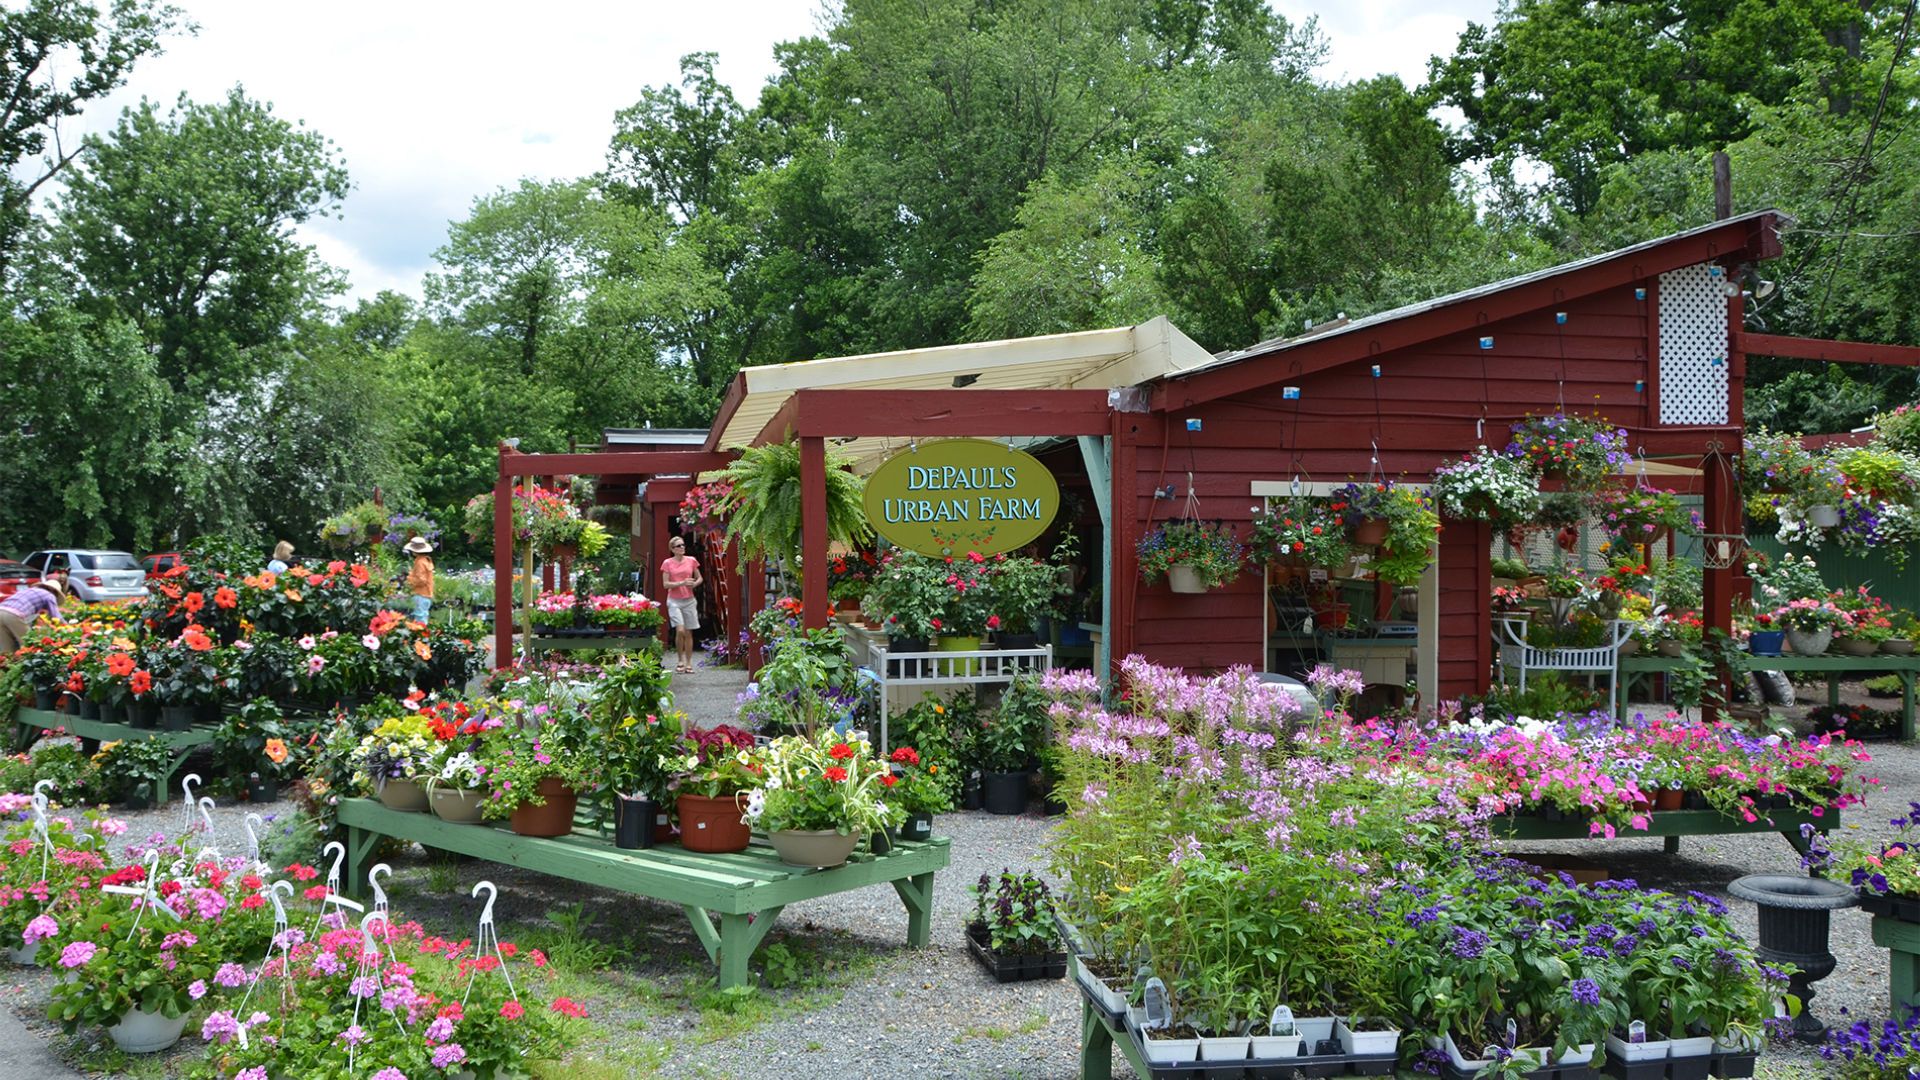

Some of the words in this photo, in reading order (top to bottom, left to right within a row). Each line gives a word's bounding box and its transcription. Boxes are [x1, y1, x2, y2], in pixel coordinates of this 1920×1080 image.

[908, 466, 1017, 490] DEPAUL'S
[883, 498, 969, 523] URBAN
[978, 496, 1041, 520] FARM
